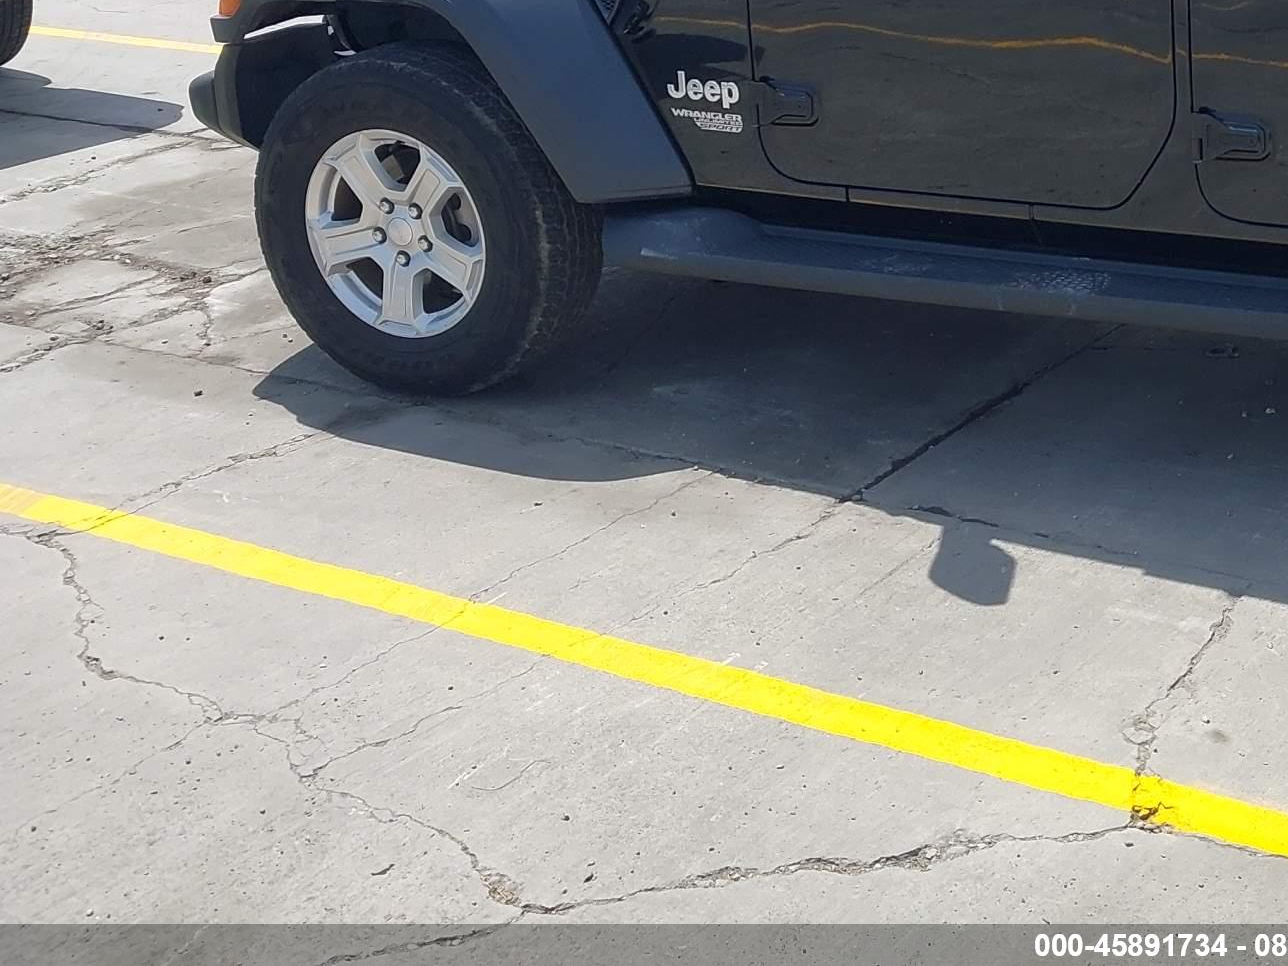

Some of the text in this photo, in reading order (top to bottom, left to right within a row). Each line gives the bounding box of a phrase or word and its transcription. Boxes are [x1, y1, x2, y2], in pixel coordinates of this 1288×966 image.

[667, 70, 740, 109] Jeep
[670, 107, 743, 122] WRANGLER
[699, 123, 741, 131] SPORT
